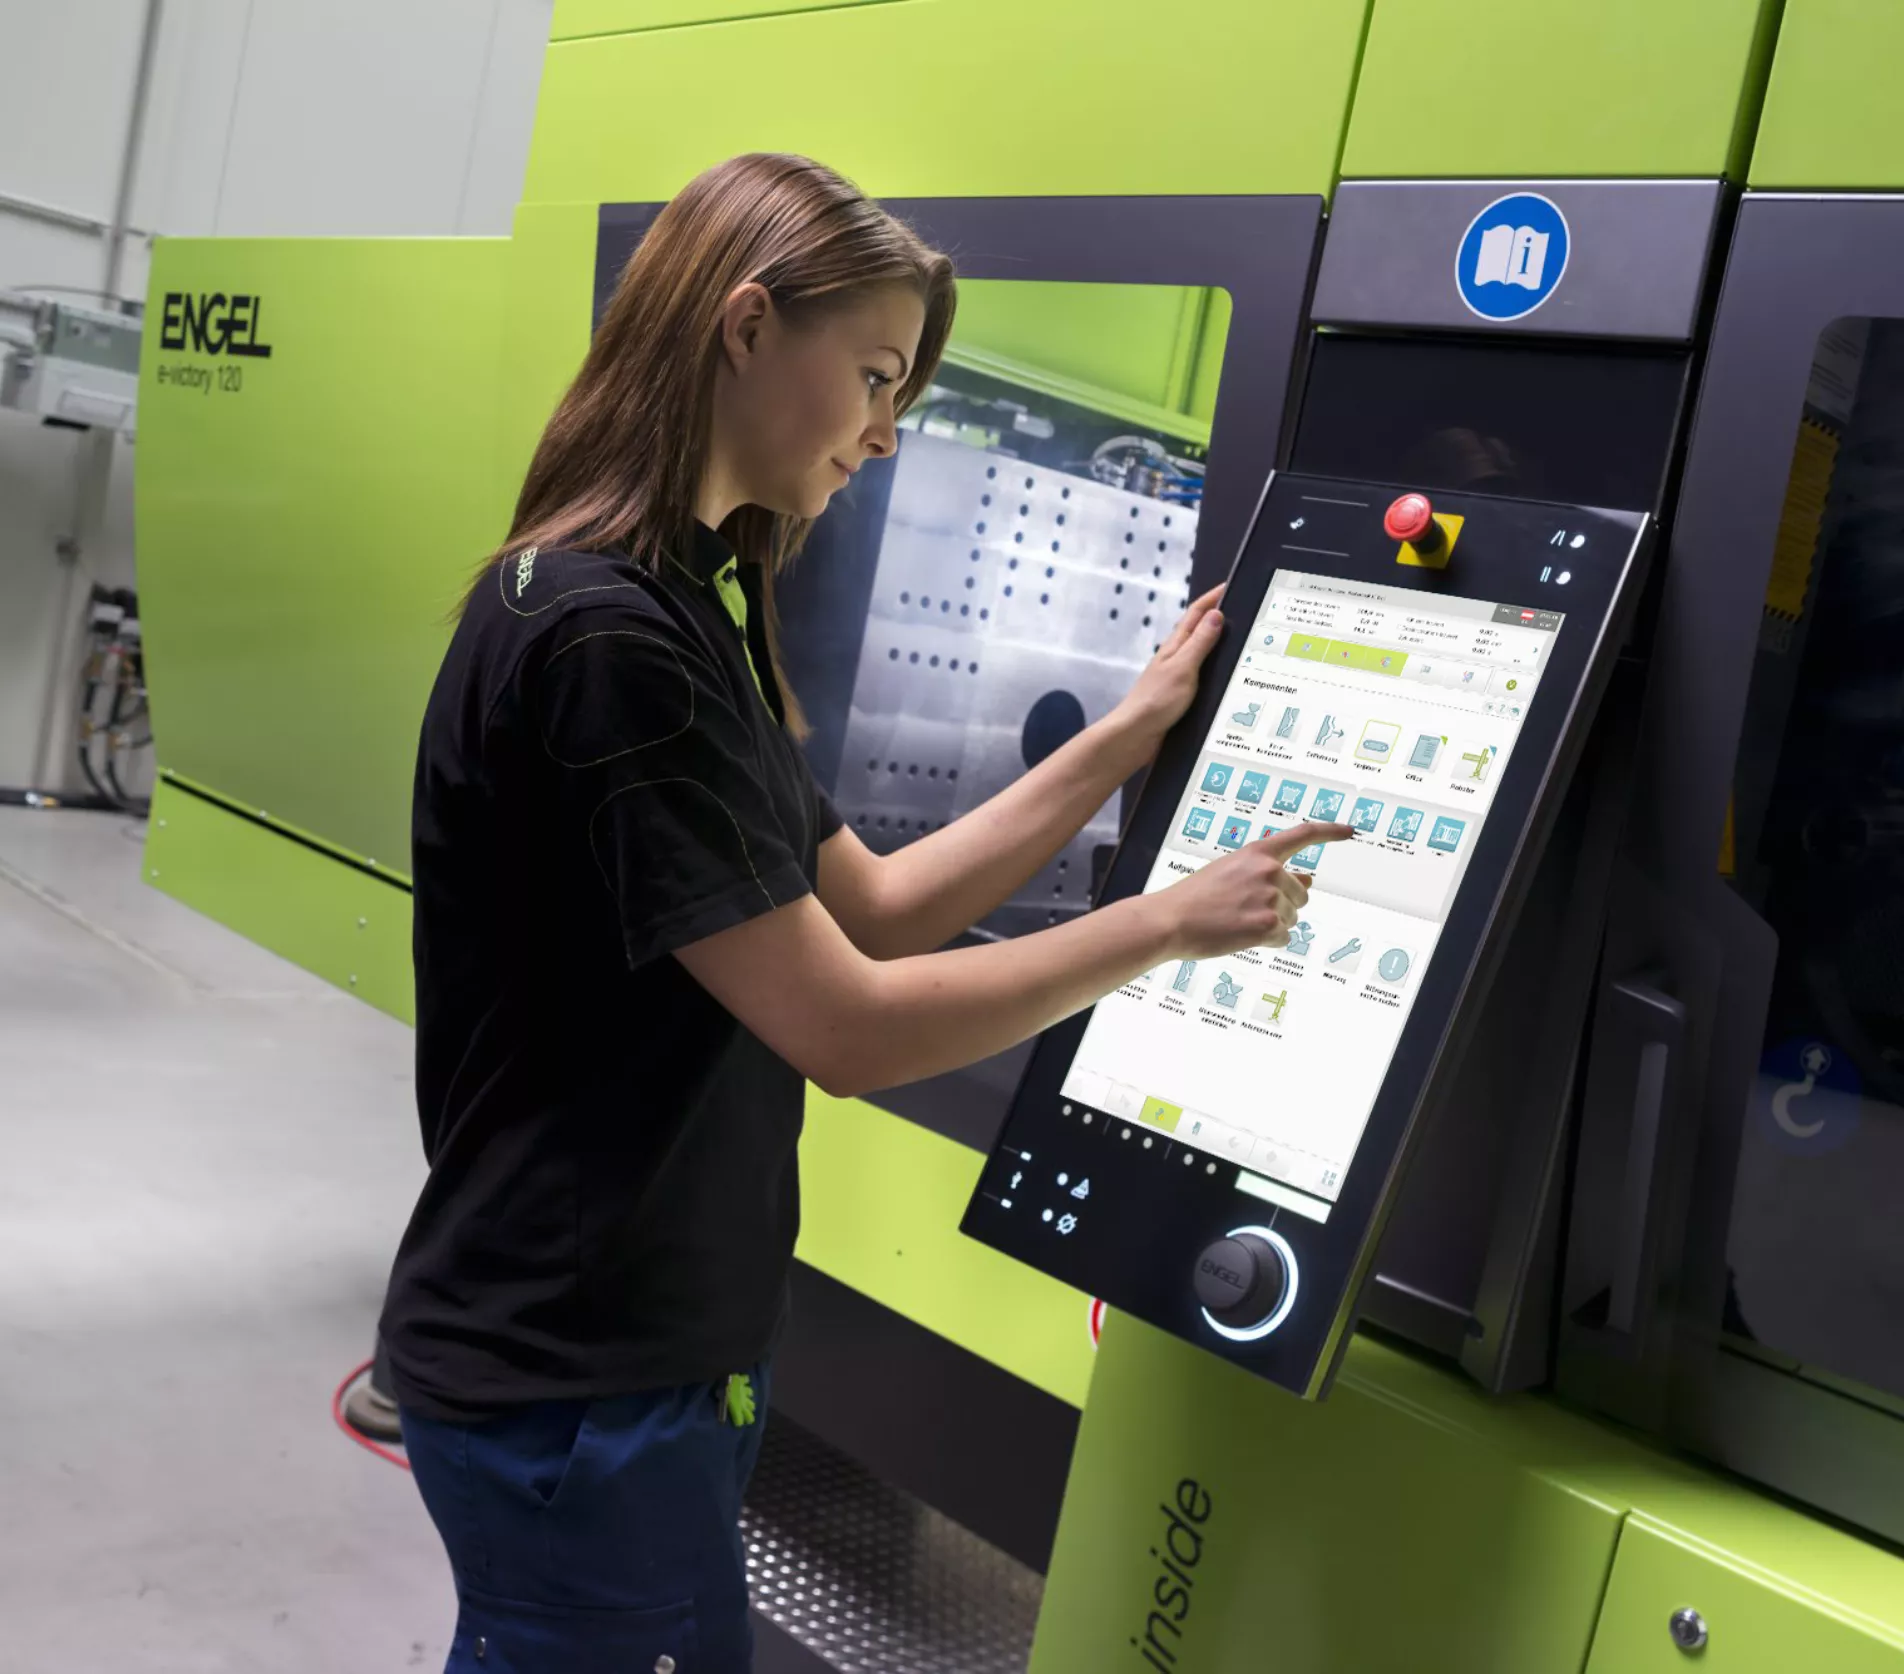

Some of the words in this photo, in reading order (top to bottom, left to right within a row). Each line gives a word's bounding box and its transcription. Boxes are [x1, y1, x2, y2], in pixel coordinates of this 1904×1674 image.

[160, 293, 272, 359] ENGEL
[157, 364, 213, 395] e-victory
[217, 365, 243, 392] 120
[516, 547, 538, 598] ENGEL
[1167, 860, 1195, 875] Aufgab
[1200, 1258, 1245, 1291] ENGEL
[1130, 1477, 1212, 1674] inside
